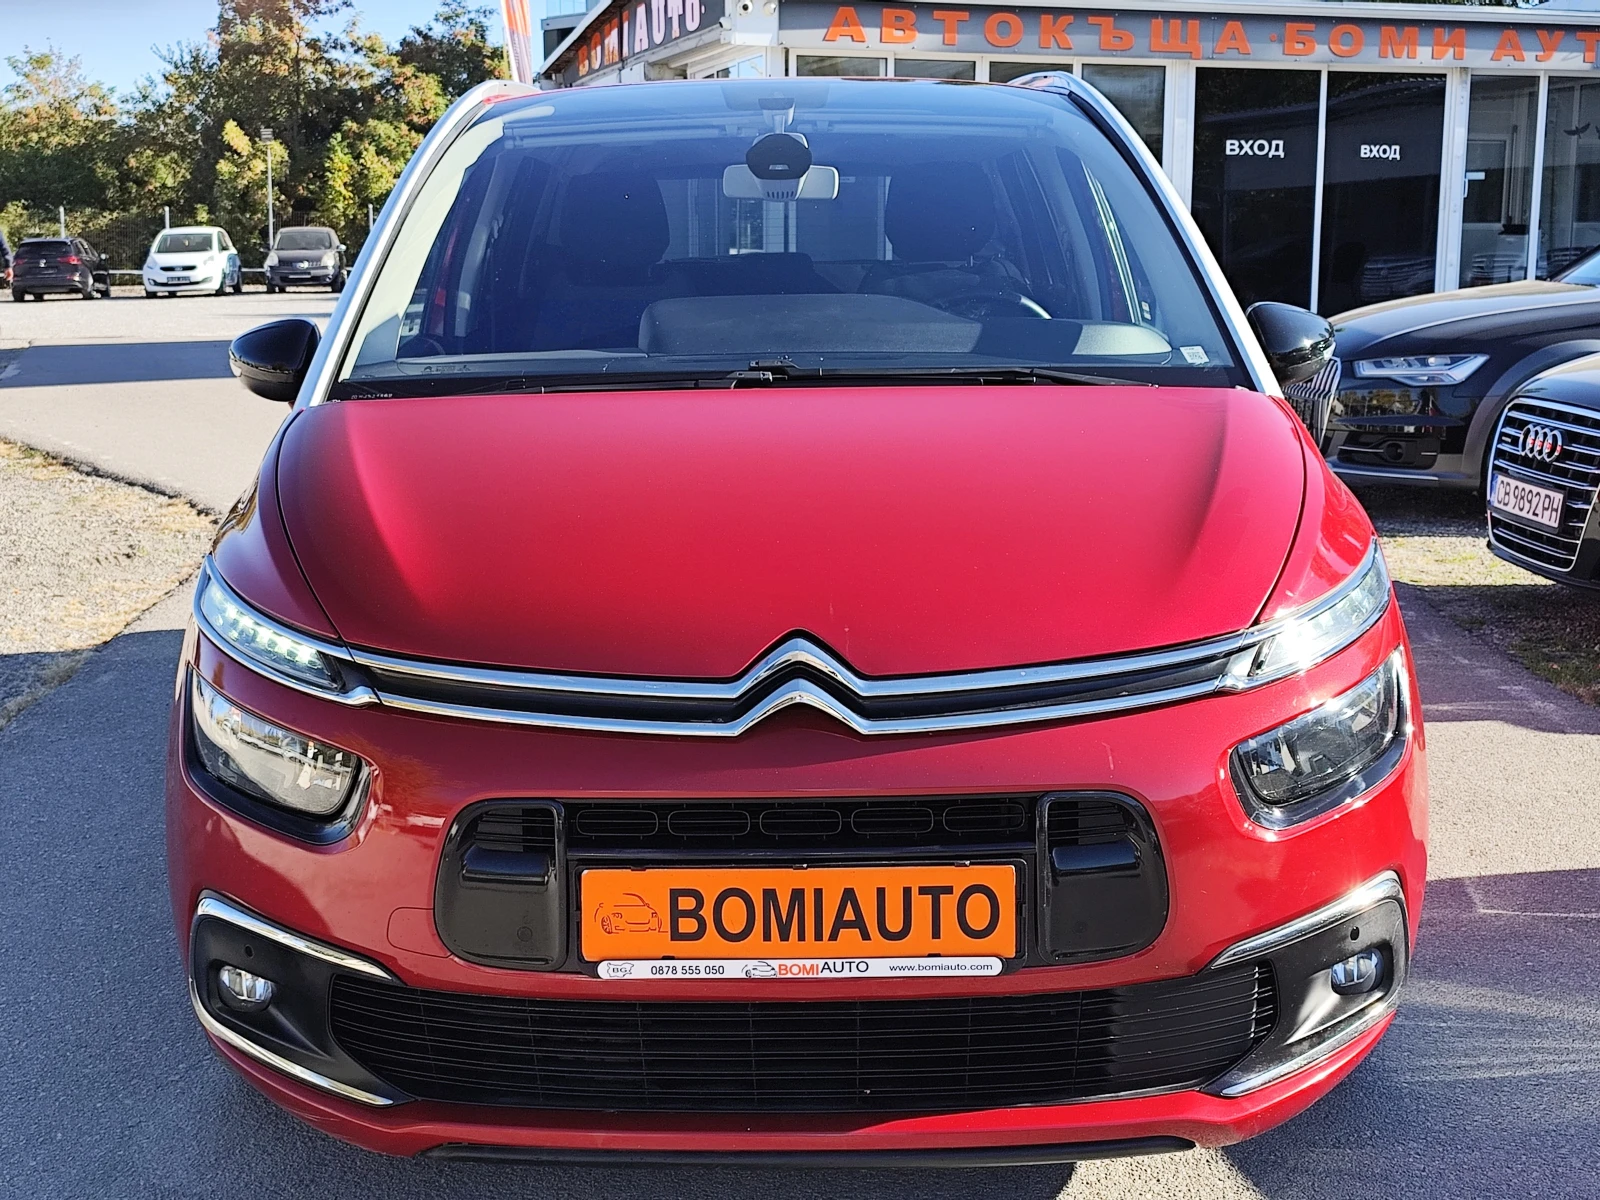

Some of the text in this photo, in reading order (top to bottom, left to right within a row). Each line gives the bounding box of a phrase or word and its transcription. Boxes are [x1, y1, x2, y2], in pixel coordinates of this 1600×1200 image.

[824, 6, 1251, 60] АВТОКЪЩА
[1283, 22, 1466, 60] БОМИ
[1225, 139, 1285, 159] ВХОД
[1360, 144, 1401, 160] ВХОД
[669, 884, 1000, 942] BOMIAUTO
[650, 965, 725, 976] 0878 555 050
[888, 963, 994, 972] www.bomiauto.com
